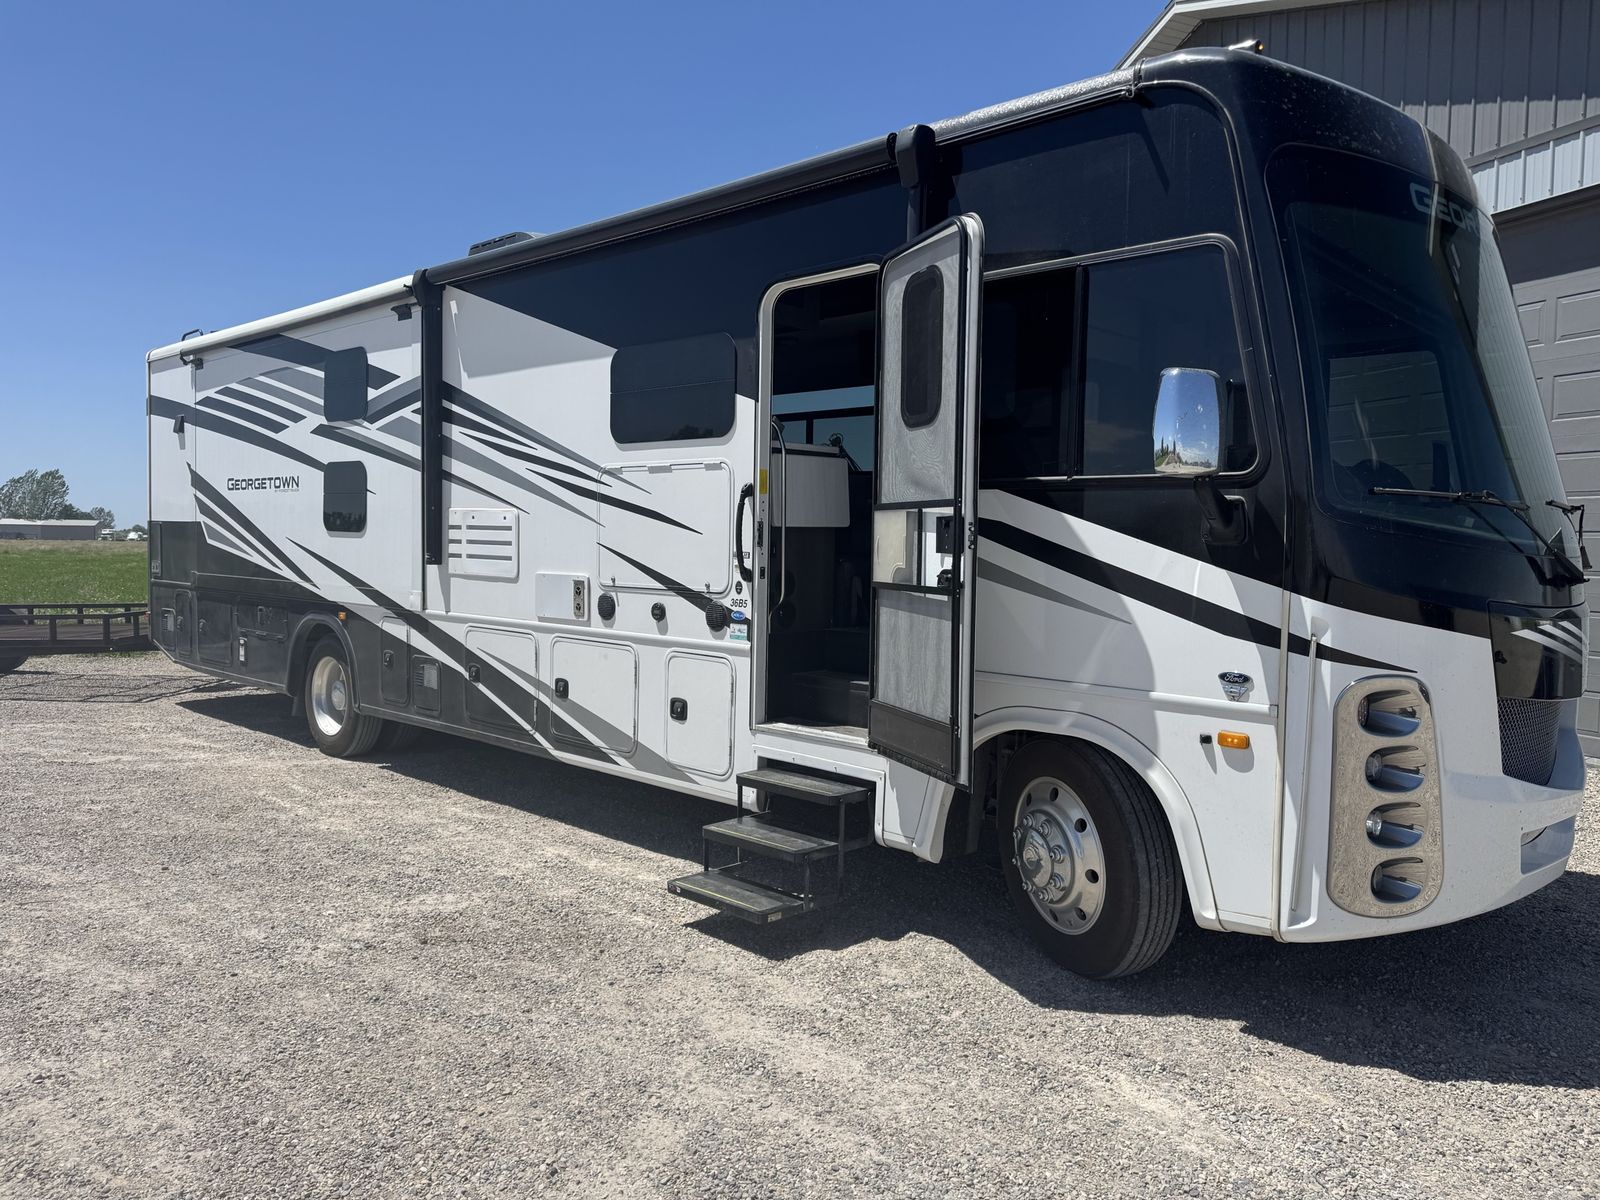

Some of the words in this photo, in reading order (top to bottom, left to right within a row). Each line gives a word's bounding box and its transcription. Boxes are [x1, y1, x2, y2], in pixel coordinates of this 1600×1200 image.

[227, 476, 299, 491] GEORGETOWN
[730, 598, 748, 608] 36B5
[1224, 672, 1245, 682] Ford
